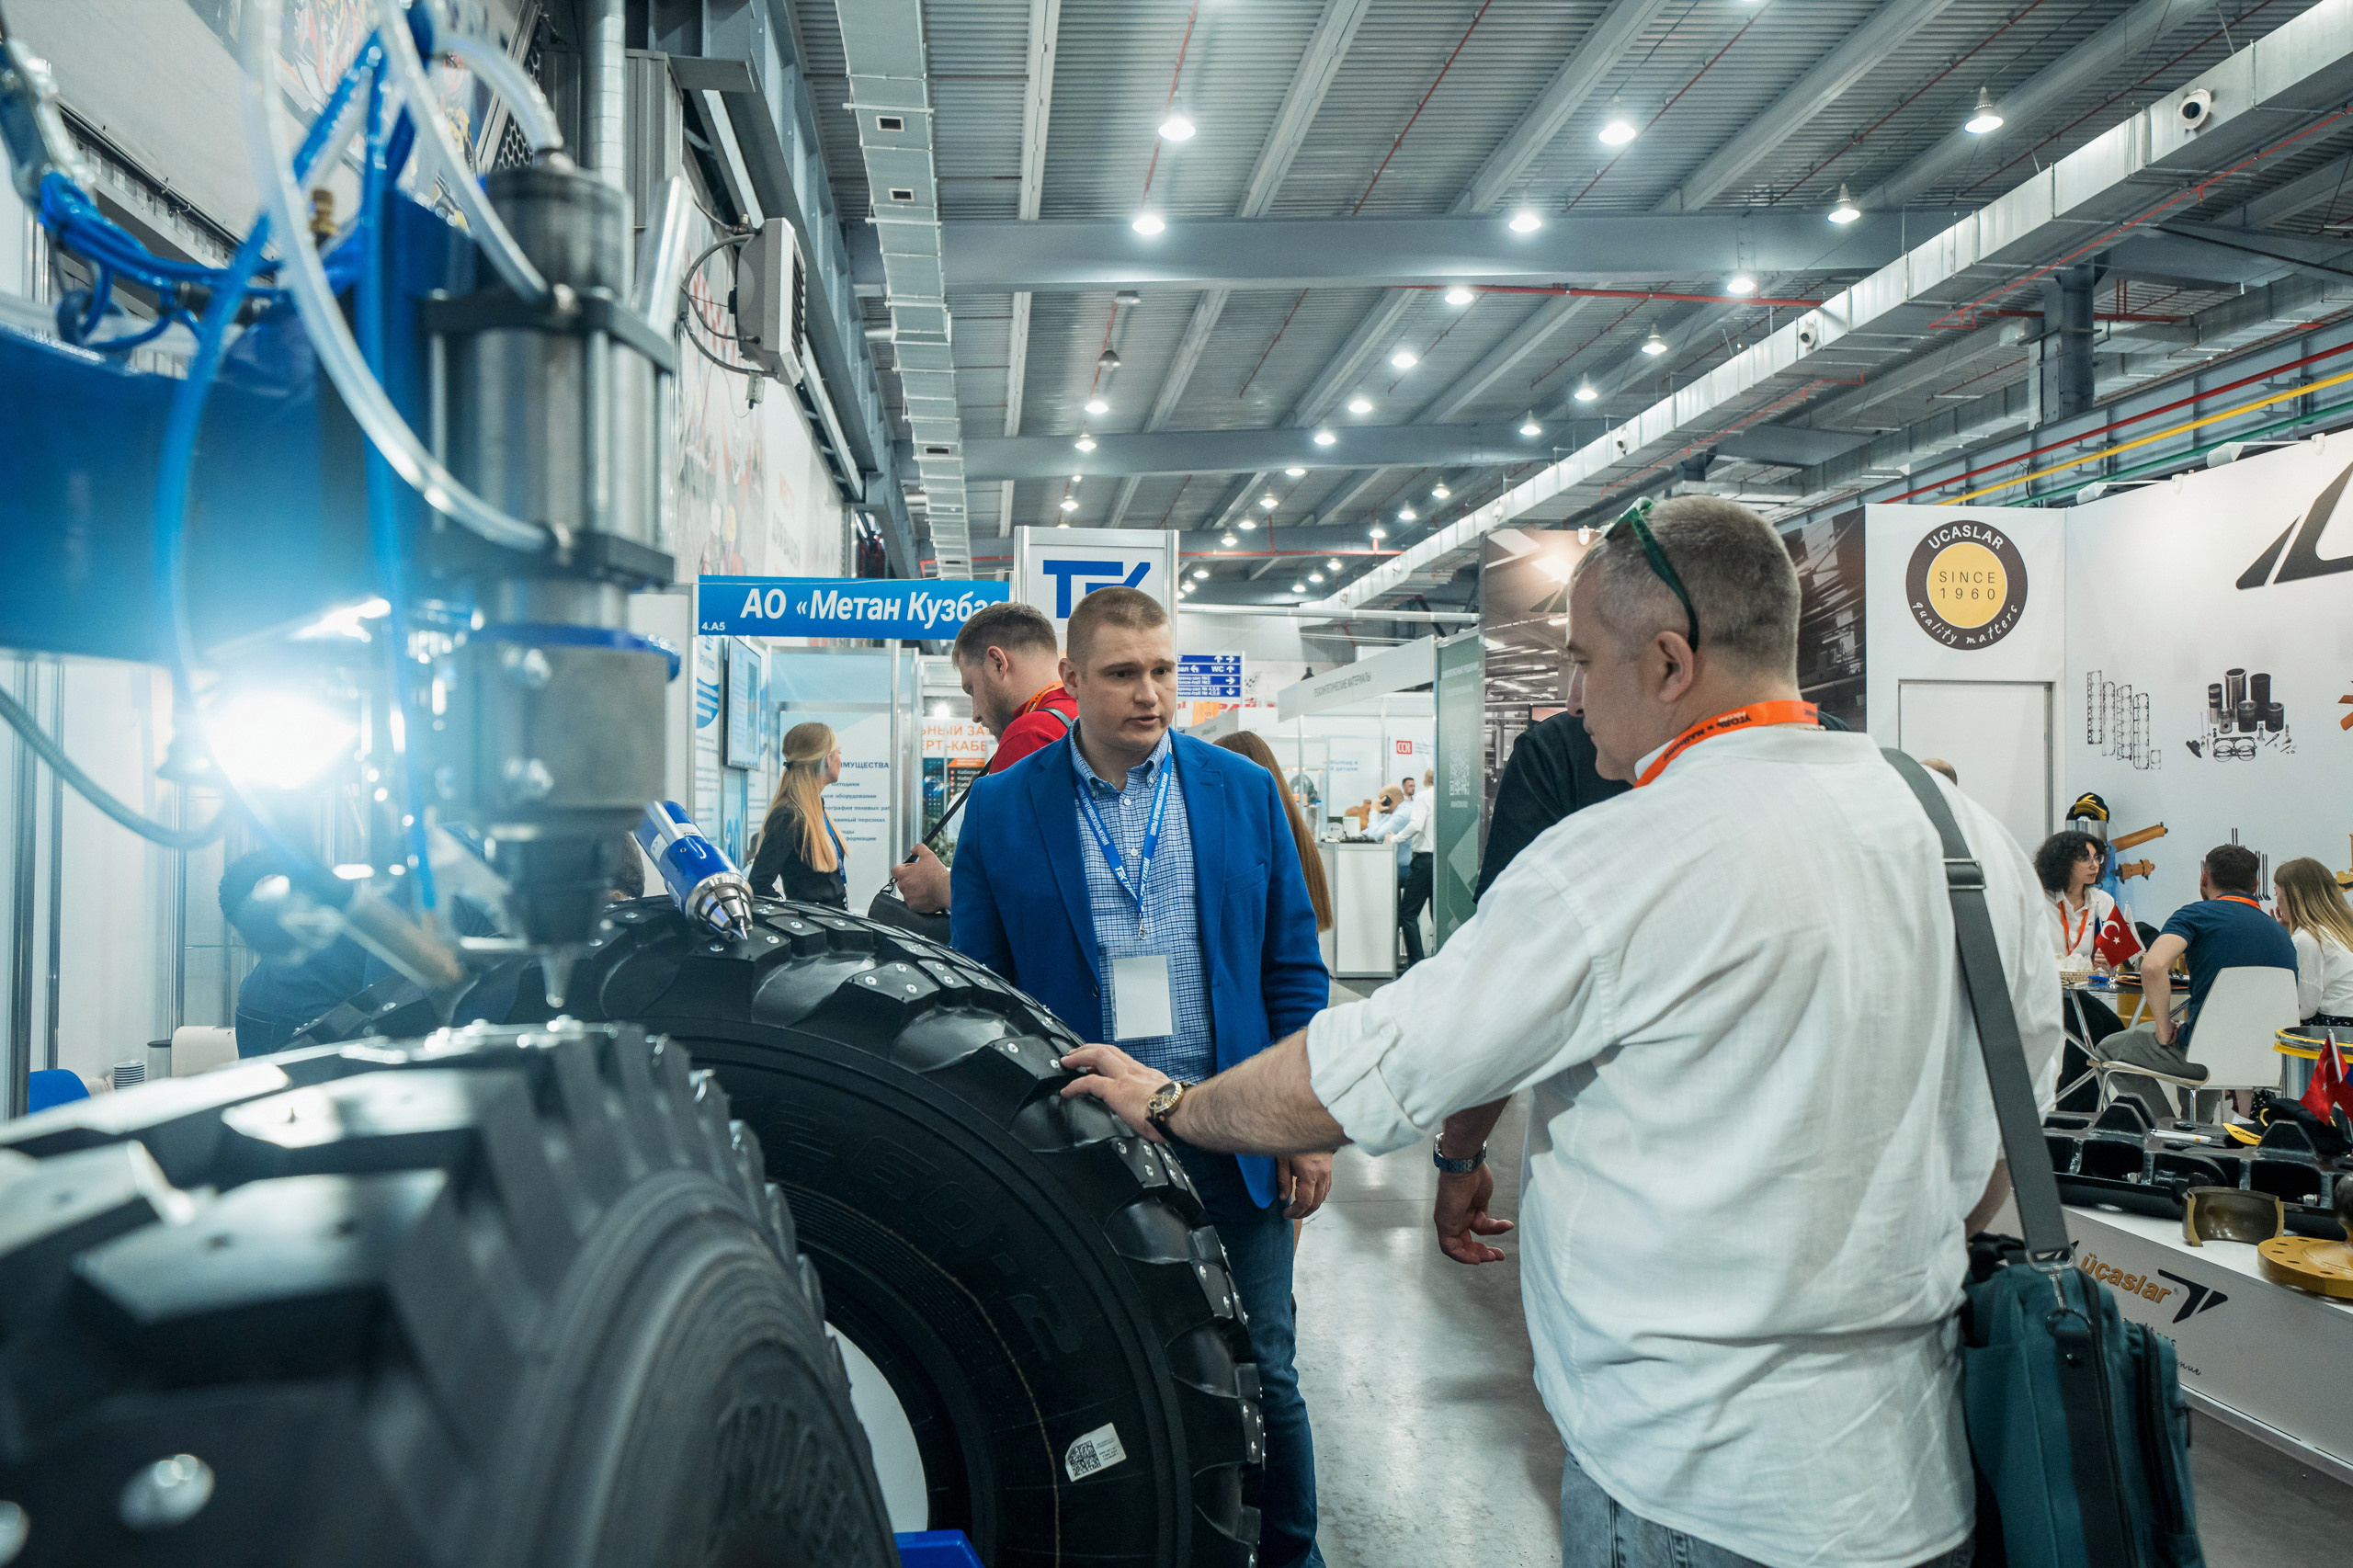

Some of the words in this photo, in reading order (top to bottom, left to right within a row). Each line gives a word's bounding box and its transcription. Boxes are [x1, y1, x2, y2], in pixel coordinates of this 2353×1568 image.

[1927, 525, 2004, 550] UCASLAR
[1938, 571, 1995, 584] SINCE
[1939, 587, 1995, 600] 1960
[739, 588, 788, 619] АО
[796, 590, 902, 622] «Метан
[906, 591, 1003, 630] Кузба
[1912, 601, 1958, 645] quality
[1966, 604, 2018, 644] matters
